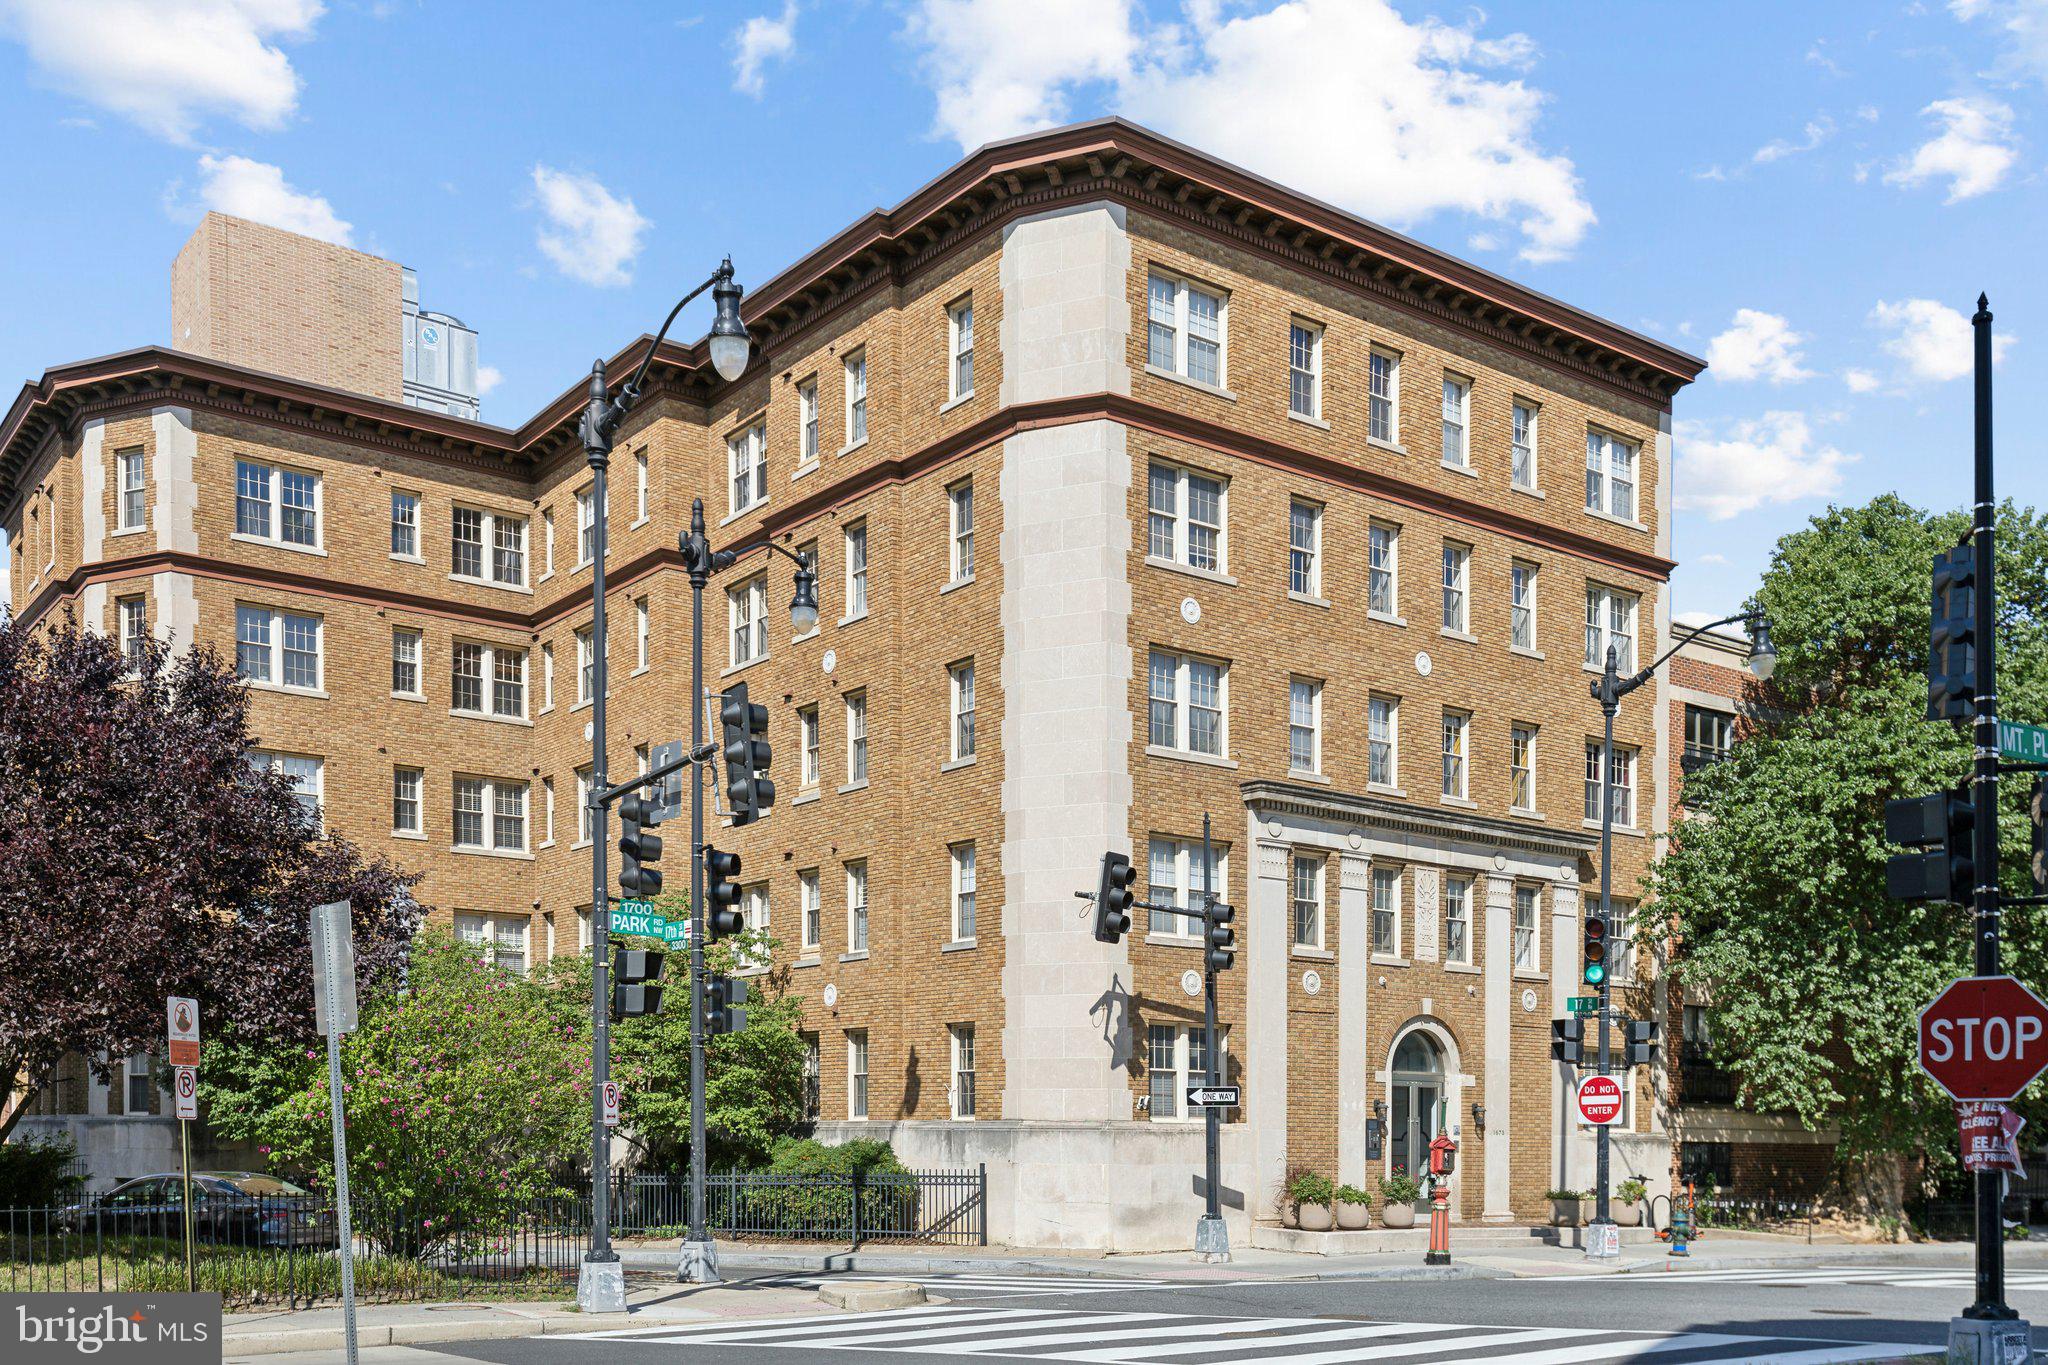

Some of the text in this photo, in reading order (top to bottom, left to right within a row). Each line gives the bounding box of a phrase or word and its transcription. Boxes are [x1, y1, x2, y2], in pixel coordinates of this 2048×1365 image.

[2004, 725, 2028, 754] MT.
[622, 902, 652, 915] 1700
[612, 914, 650, 933] PARK
[653, 918, 663, 926] RD
[665, 925, 678, 939] 17th
[671, 940, 686, 950] 3300
[1574, 998, 1584, 1010] 17
[1928, 1015, 2043, 1062] STOP
[1584, 1085, 1616, 1094] DO NOT
[1202, 1092, 1234, 1101] ONE WAY
[1587, 1106, 1613, 1115] ENTER
